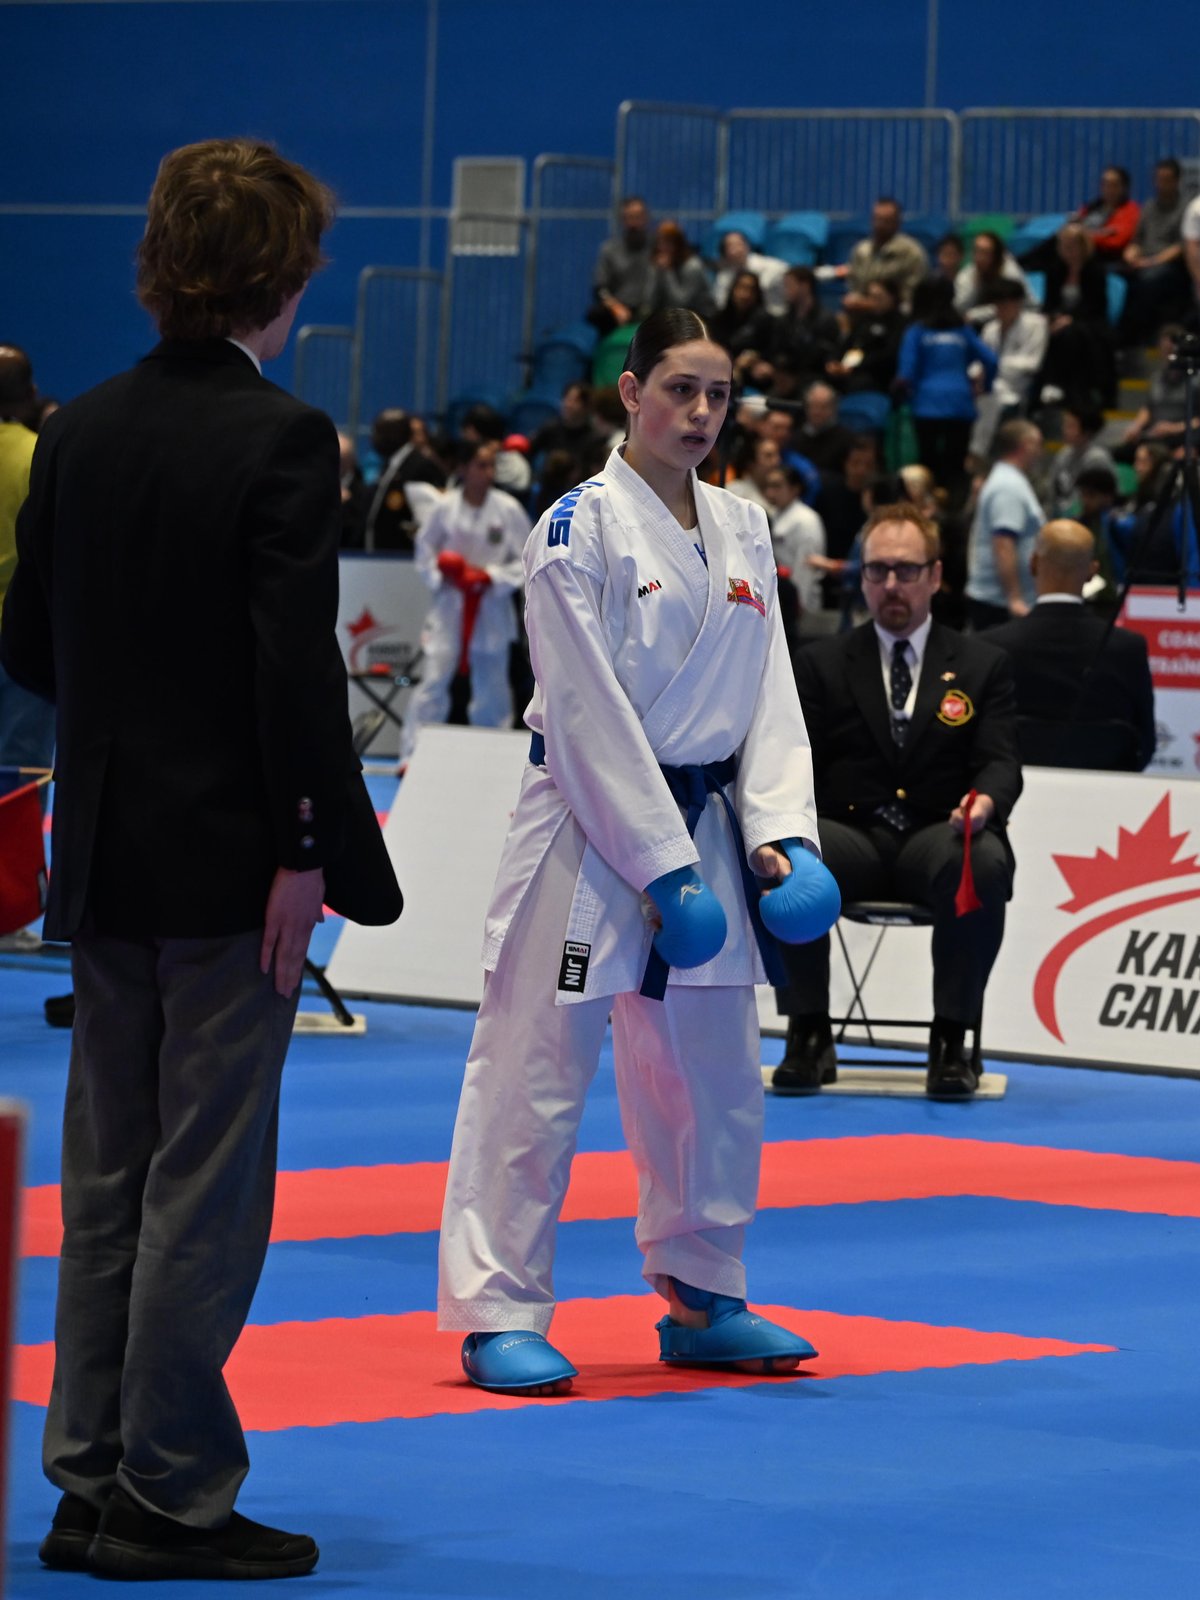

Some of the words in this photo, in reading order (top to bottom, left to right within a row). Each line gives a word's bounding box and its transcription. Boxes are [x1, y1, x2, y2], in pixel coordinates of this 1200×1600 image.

[637, 579, 662, 599] MAI
[568, 946, 587, 954] SMAI
[565, 958, 582, 986] JIN
